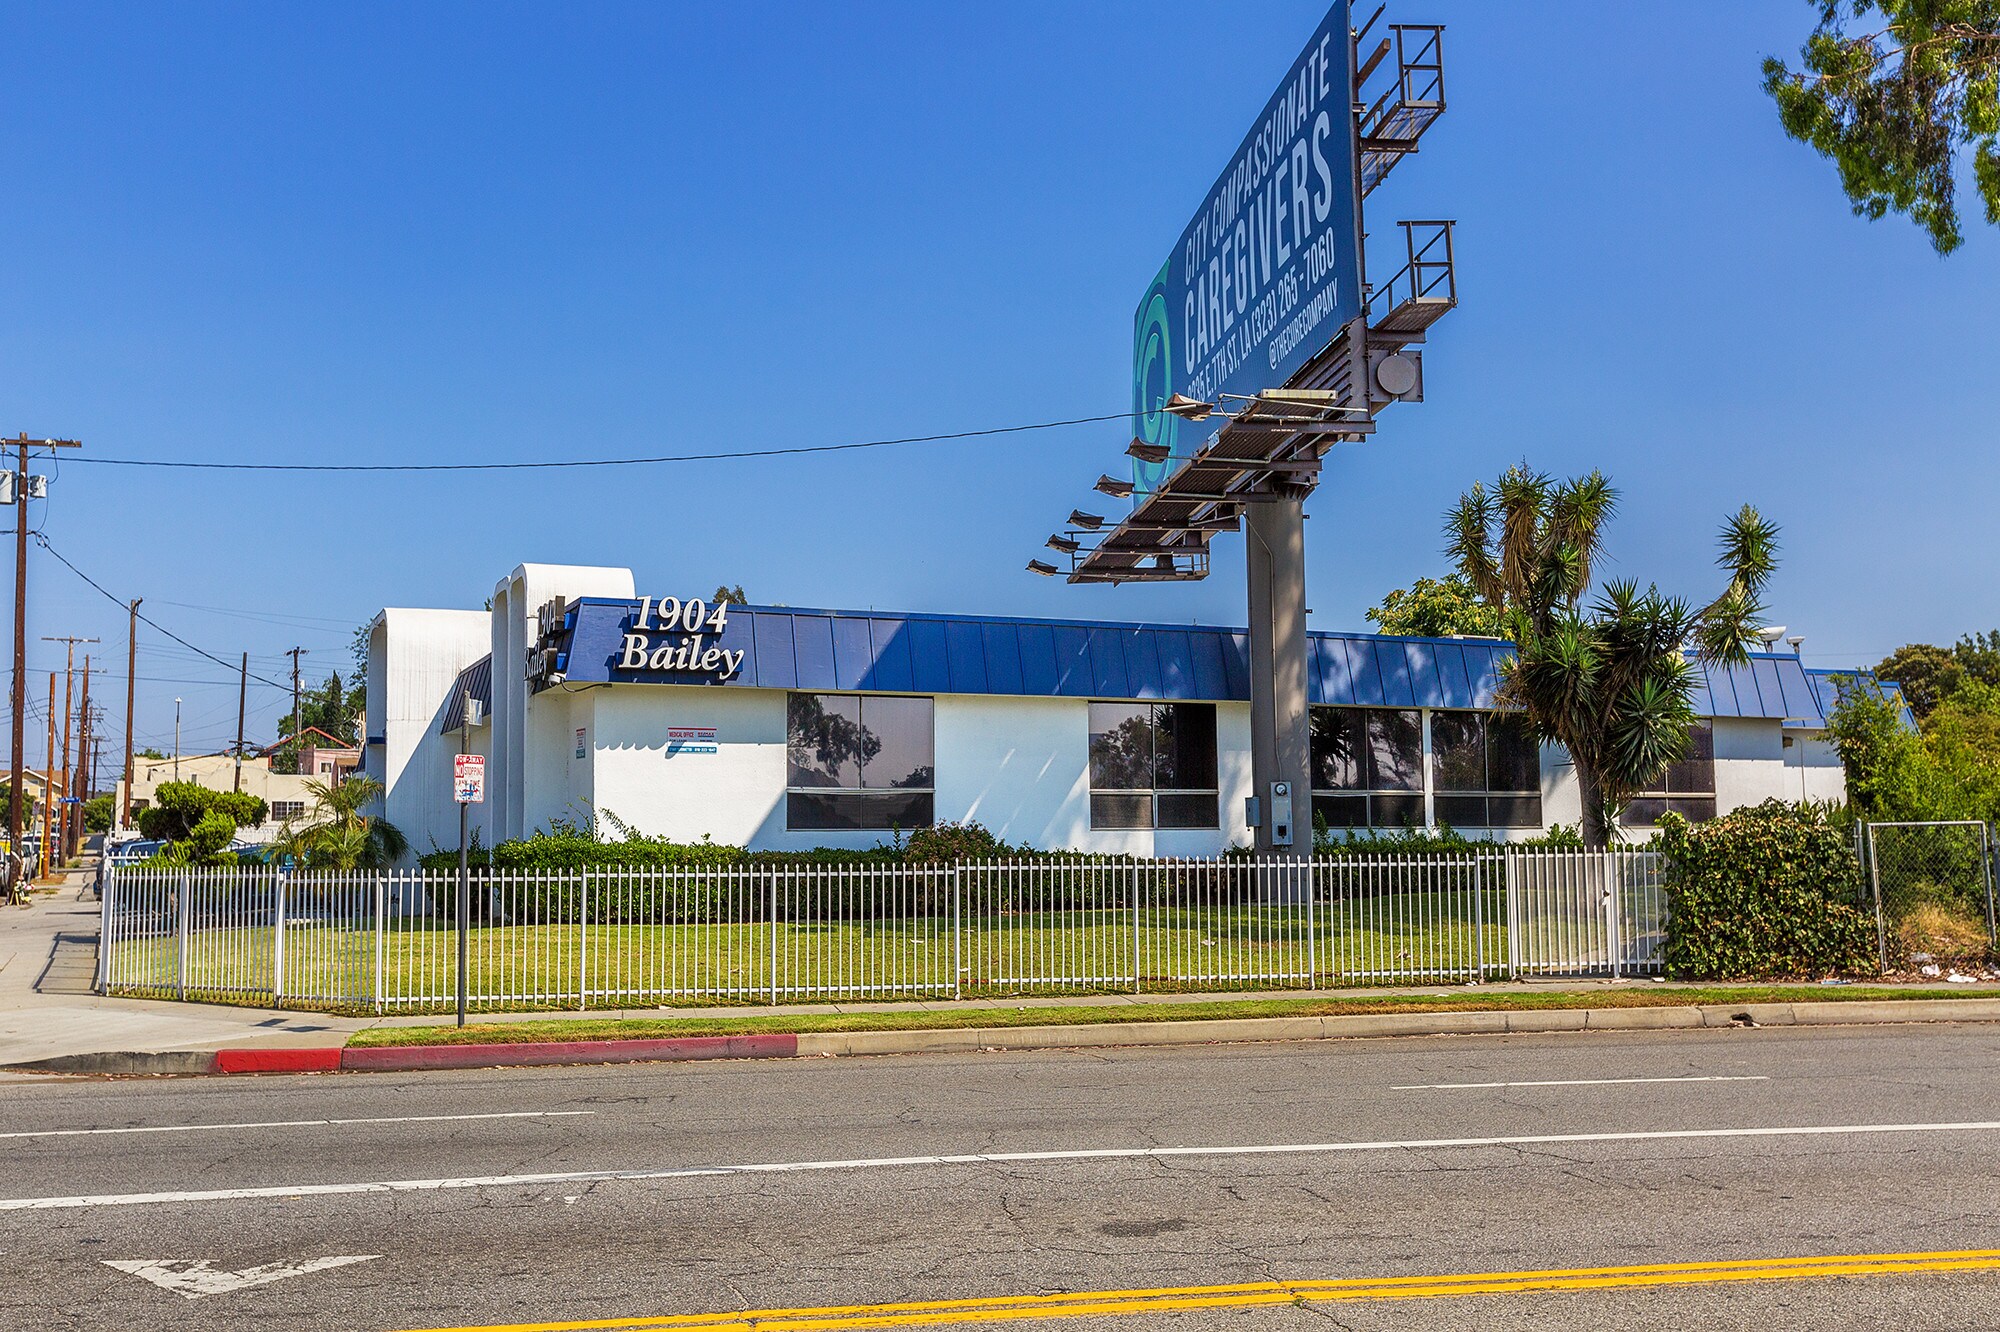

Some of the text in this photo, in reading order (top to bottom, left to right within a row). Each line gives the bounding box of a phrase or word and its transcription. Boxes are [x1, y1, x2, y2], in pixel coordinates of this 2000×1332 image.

[1185, 31, 1331, 286] CITY COMPASSIONATE
[1185, 110, 1333, 375] CAREGIVERS
[1239, 319, 1252, 361] LA
[1251, 289, 1277, 347] (323)
[1269, 277, 1338, 370] @THECURECOMPANY
[633, 595, 728, 633] 1904
[619, 634, 745, 680] Bailey
[455, 765, 483, 777] NO STOPPING
